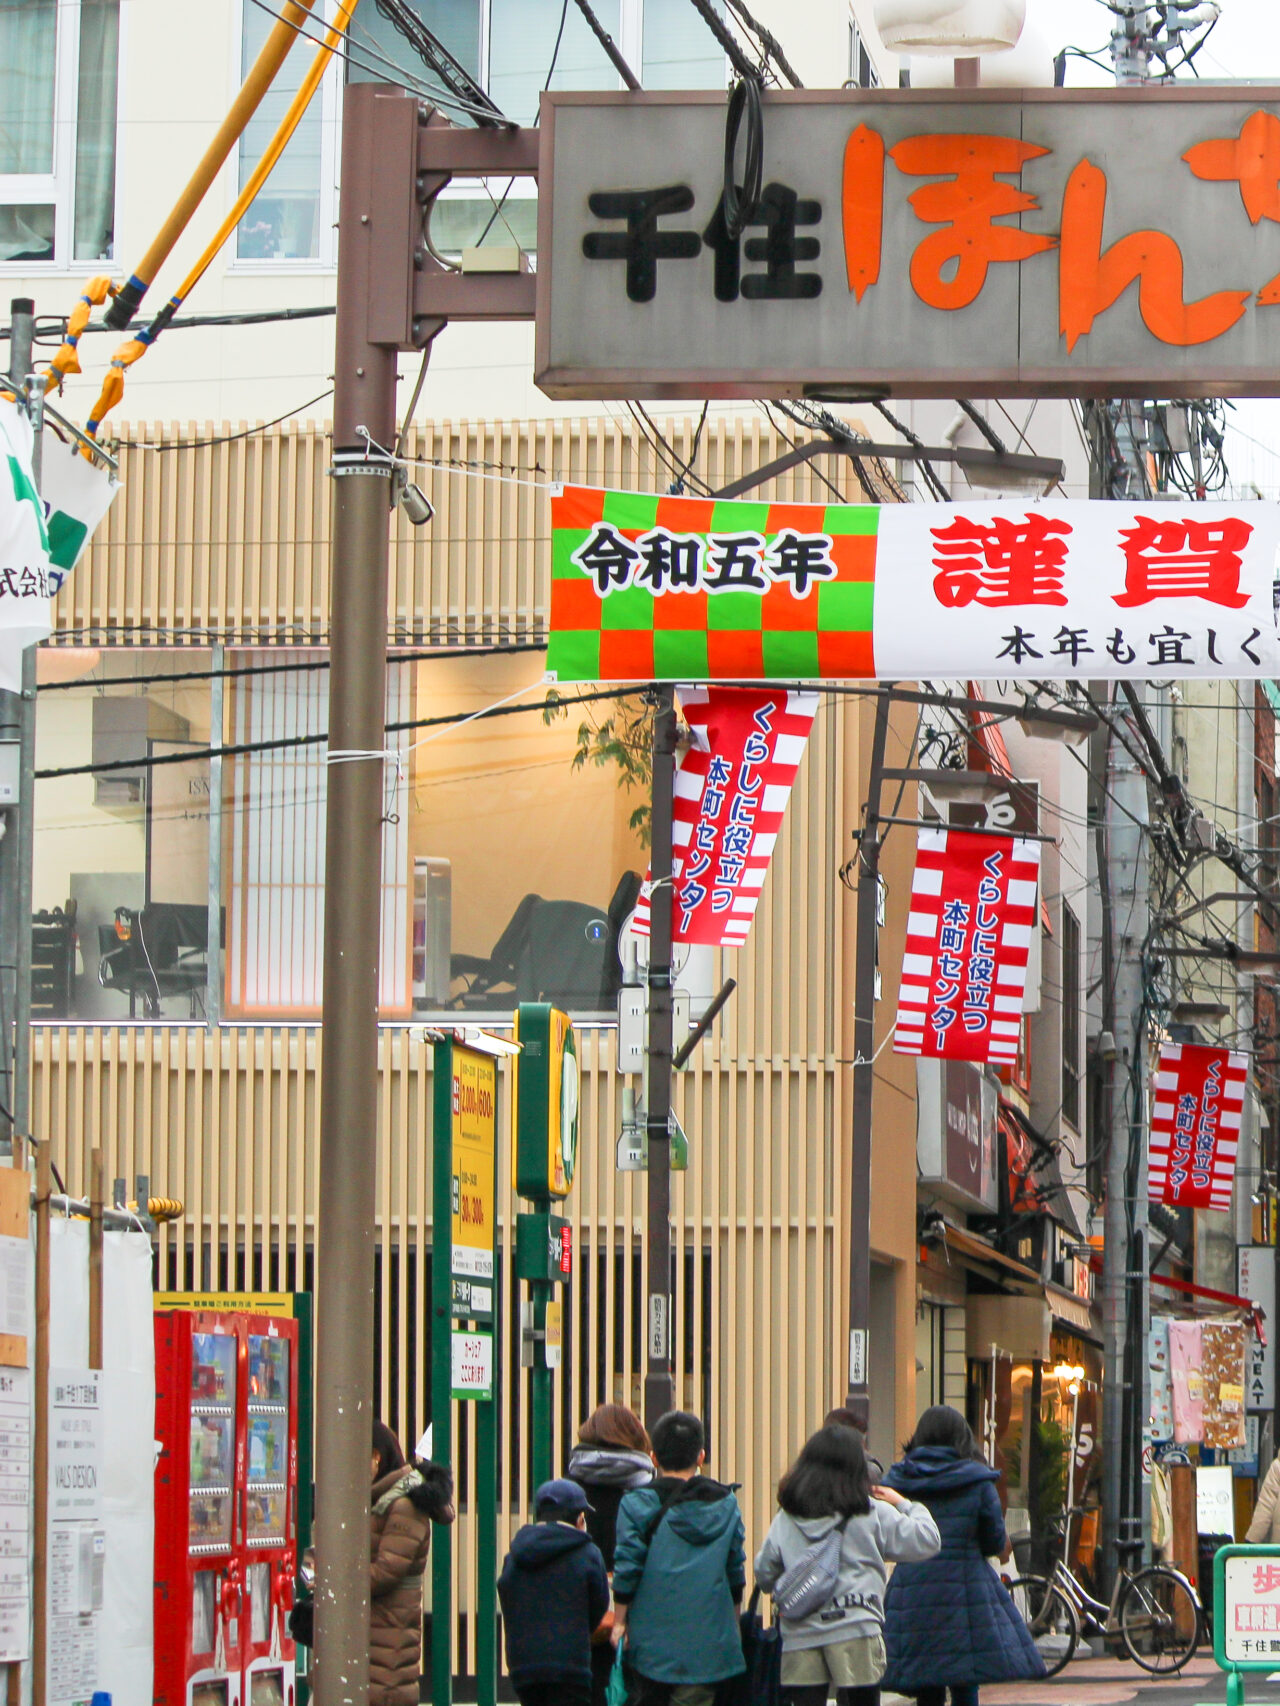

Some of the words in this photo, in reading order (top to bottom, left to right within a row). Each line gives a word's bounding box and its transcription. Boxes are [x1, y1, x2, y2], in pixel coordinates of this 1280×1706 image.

[577, 527, 831, 594] 令和五年
[680, 757, 731, 933] 本町センター
[711, 702, 775, 913] くらしに役立つ
[930, 901, 969, 1050] 本町センター
[963, 851, 1003, 1033] くらしに役立つ
[1170, 1093, 1197, 1199] 本町センター
[1193, 1059, 1221, 1189] くらしに役立つ
